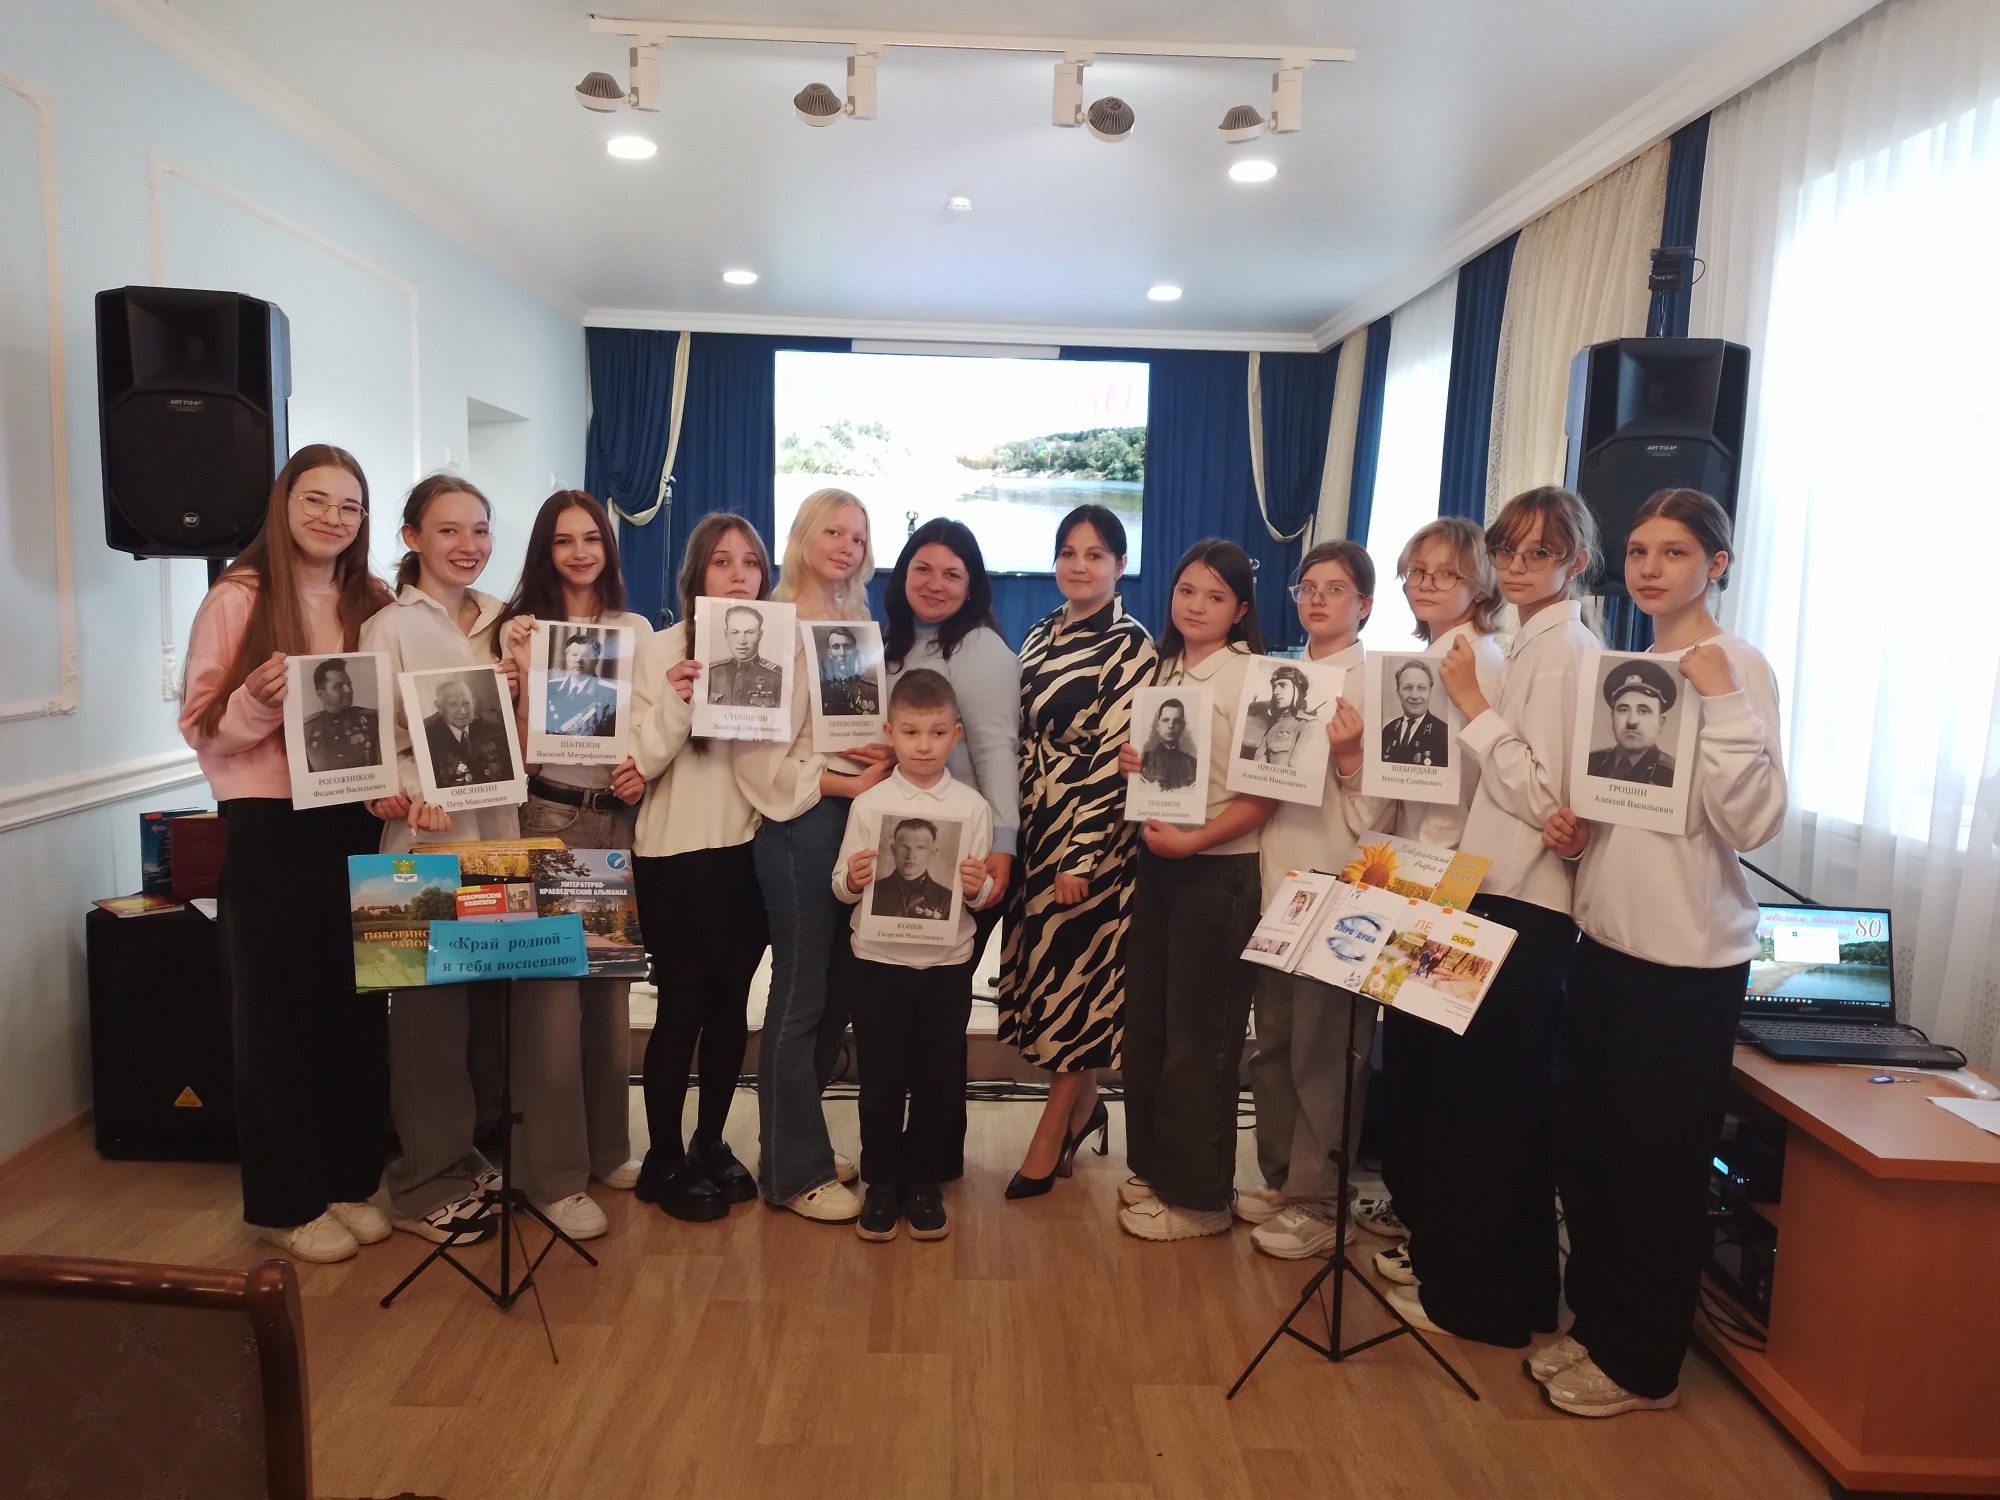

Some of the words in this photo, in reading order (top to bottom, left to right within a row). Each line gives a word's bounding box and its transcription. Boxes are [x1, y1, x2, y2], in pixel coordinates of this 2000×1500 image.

[560, 741, 601, 749] ШАТИЛОВ
[536, 750, 566, 758] Василий
[567, 751, 617, 760] Митрофанович
[1241, 771, 1268, 781] Алексей
[1257, 763, 1297, 776] ПРОХОРОВ
[1391, 764, 1438, 775] ШЕБОРДАЕВ
[318, 772, 376, 786] РОГОЖНИКОВ
[1381, 775, 1405, 784] Виктор
[312, 786, 345, 798] Федосий
[450, 784, 498, 797] ОВСЯНКИН
[1608, 783, 1648, 797] ТРОШИН
[446, 799, 465, 810] Петр
[465, 796, 508, 808] Максимович
[1593, 795, 1626, 807] Алексей
[1627, 800, 1674, 815] Васильевич
[1855, 917, 1883, 938] 80
[449, 936, 499, 953] «Край
[508, 933, 560, 952] родной
[1355, 931, 1377, 944] ДУШИ
[442, 962, 451, 972] я
[456, 960, 492, 972] тебя
[497, 955, 577, 971] воспеваю»
